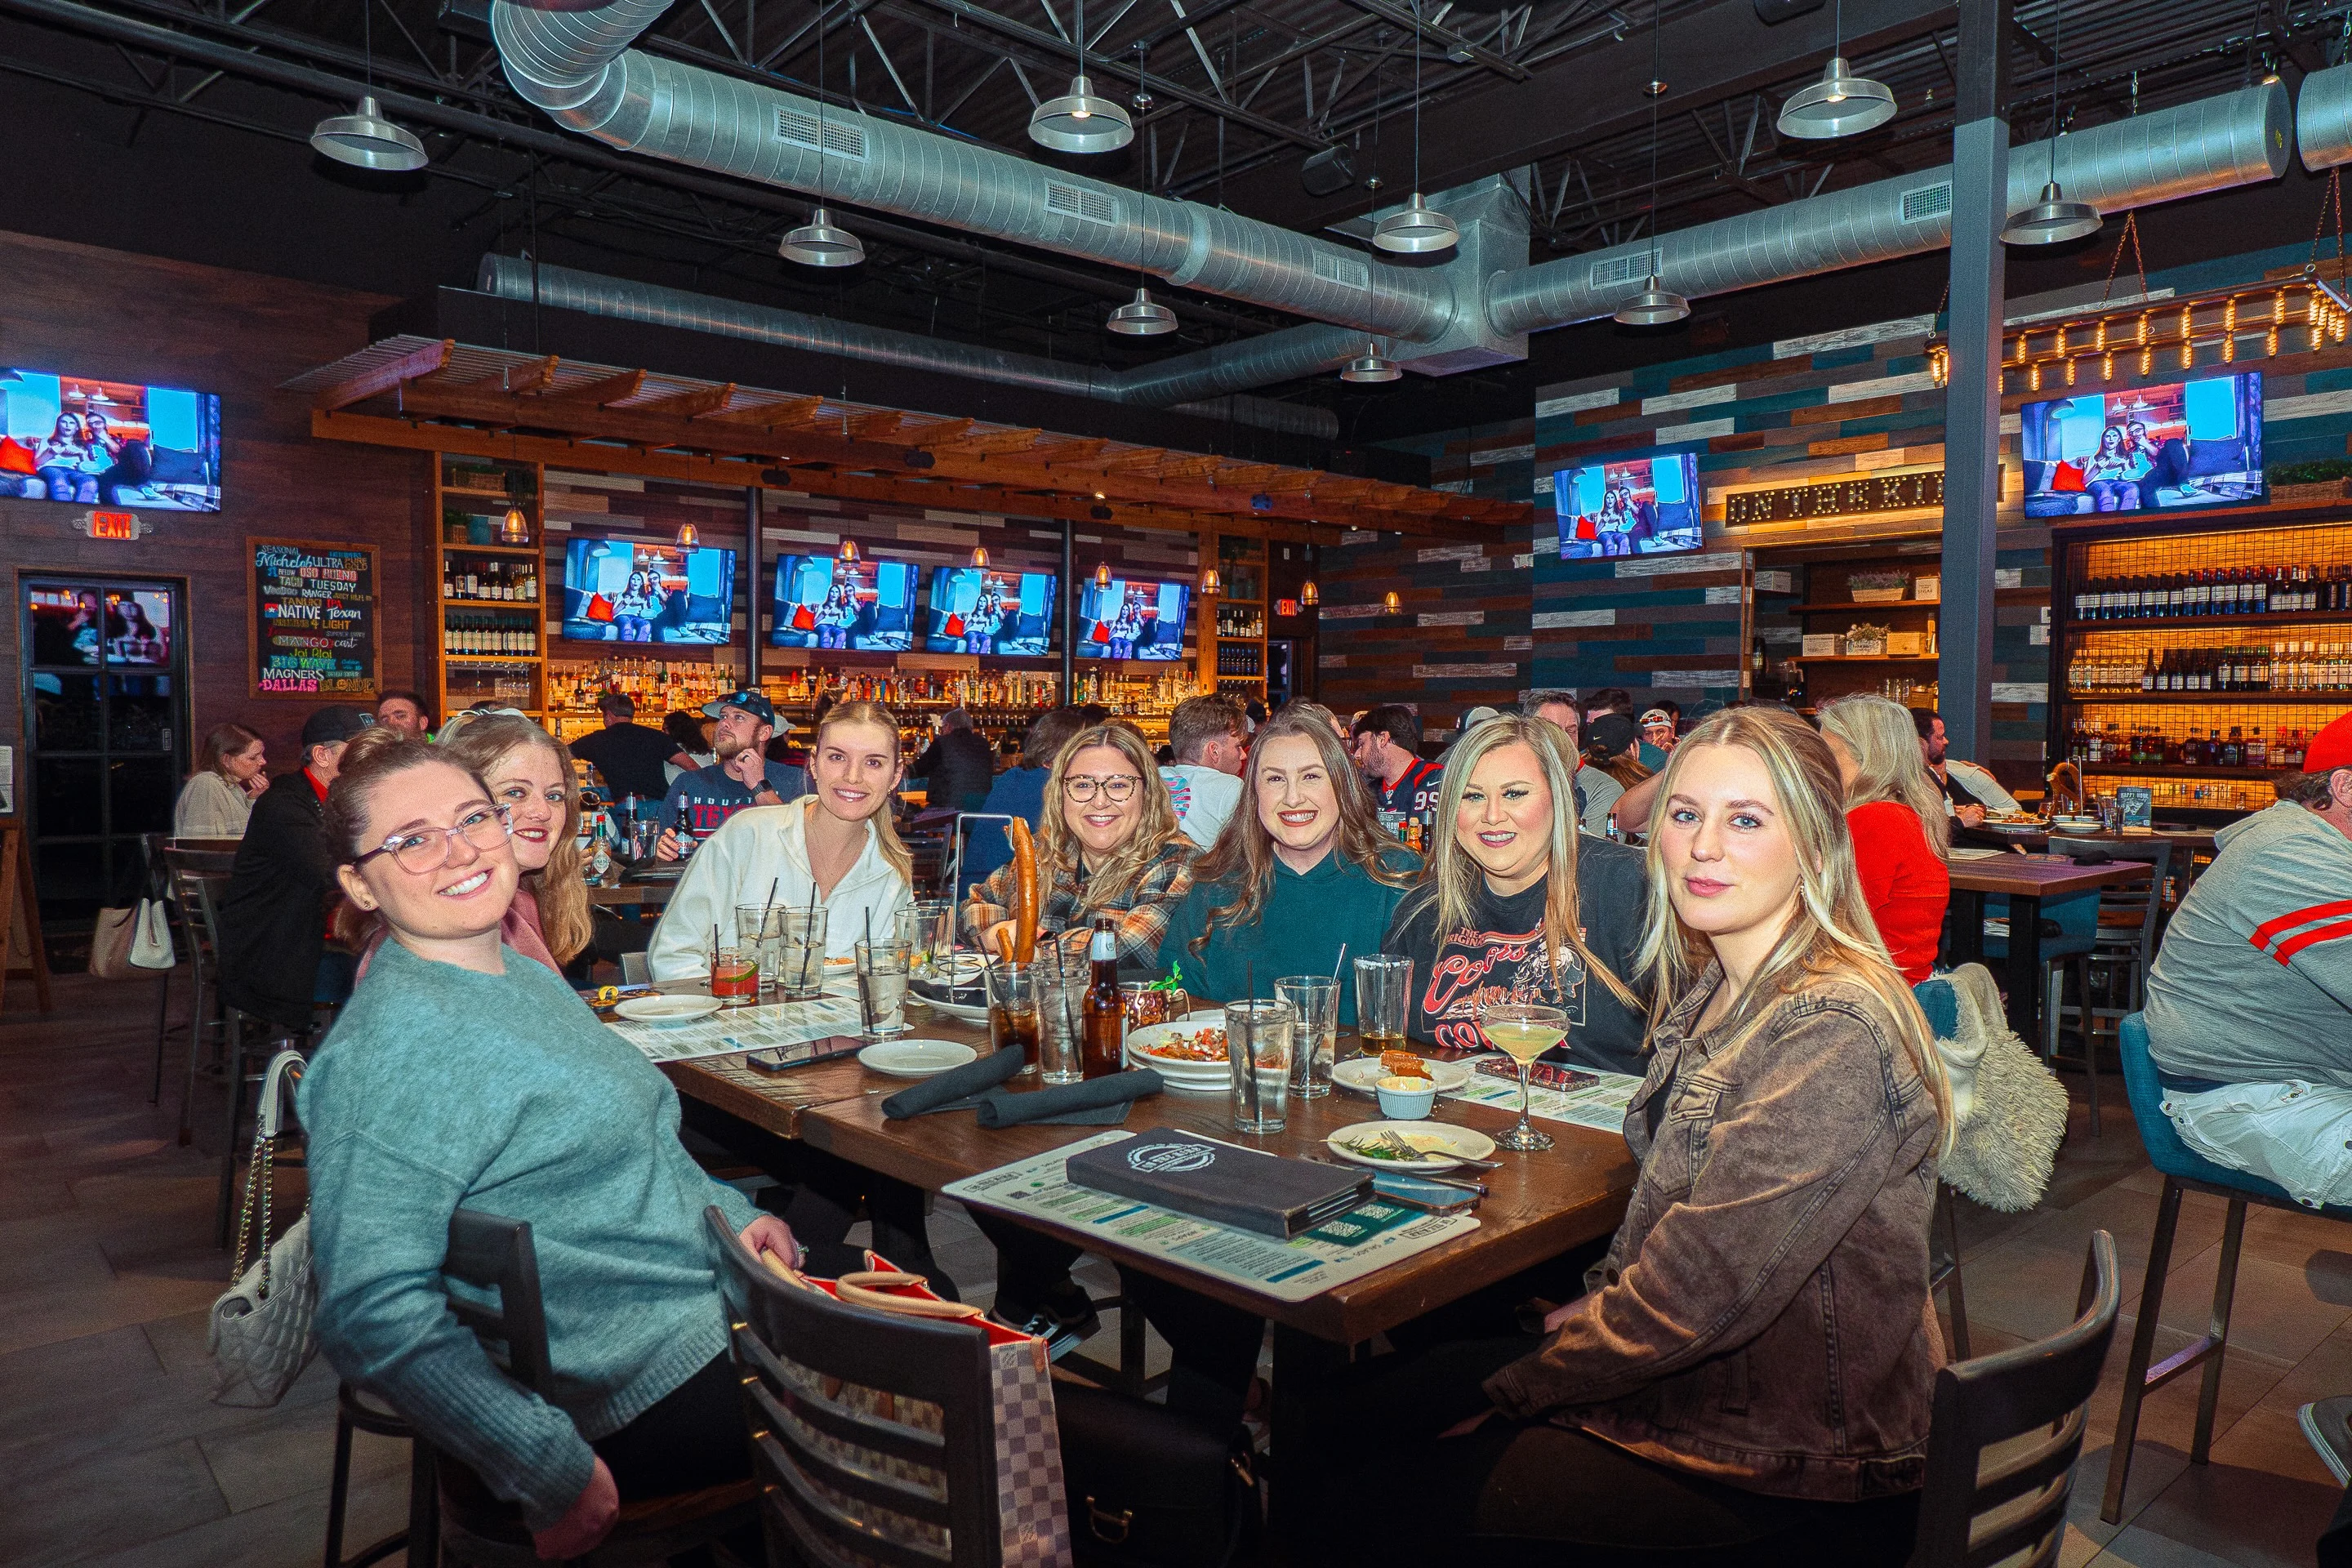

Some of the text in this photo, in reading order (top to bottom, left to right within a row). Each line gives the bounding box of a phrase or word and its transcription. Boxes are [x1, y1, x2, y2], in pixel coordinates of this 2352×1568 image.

[94, 513, 132, 539] EXIT
[312, 556, 344, 570] ULTRA
[310, 579, 357, 593] TUESDAY
[301, 589, 332, 599] RANGER
[327, 599, 343, 609] IPA
[1281, 600, 1296, 616] EXIT
[278, 604, 362, 621] NATIVE Texan
[322, 620, 352, 630] LIGHT
[277, 636, 330, 648] MANGO
[270, 656, 297, 669] BIG
[262, 667, 325, 681] MAGNERS
[261, 678, 375, 693] DALLAS BLONDE
[1423, 943, 1529, 1014] Coors
